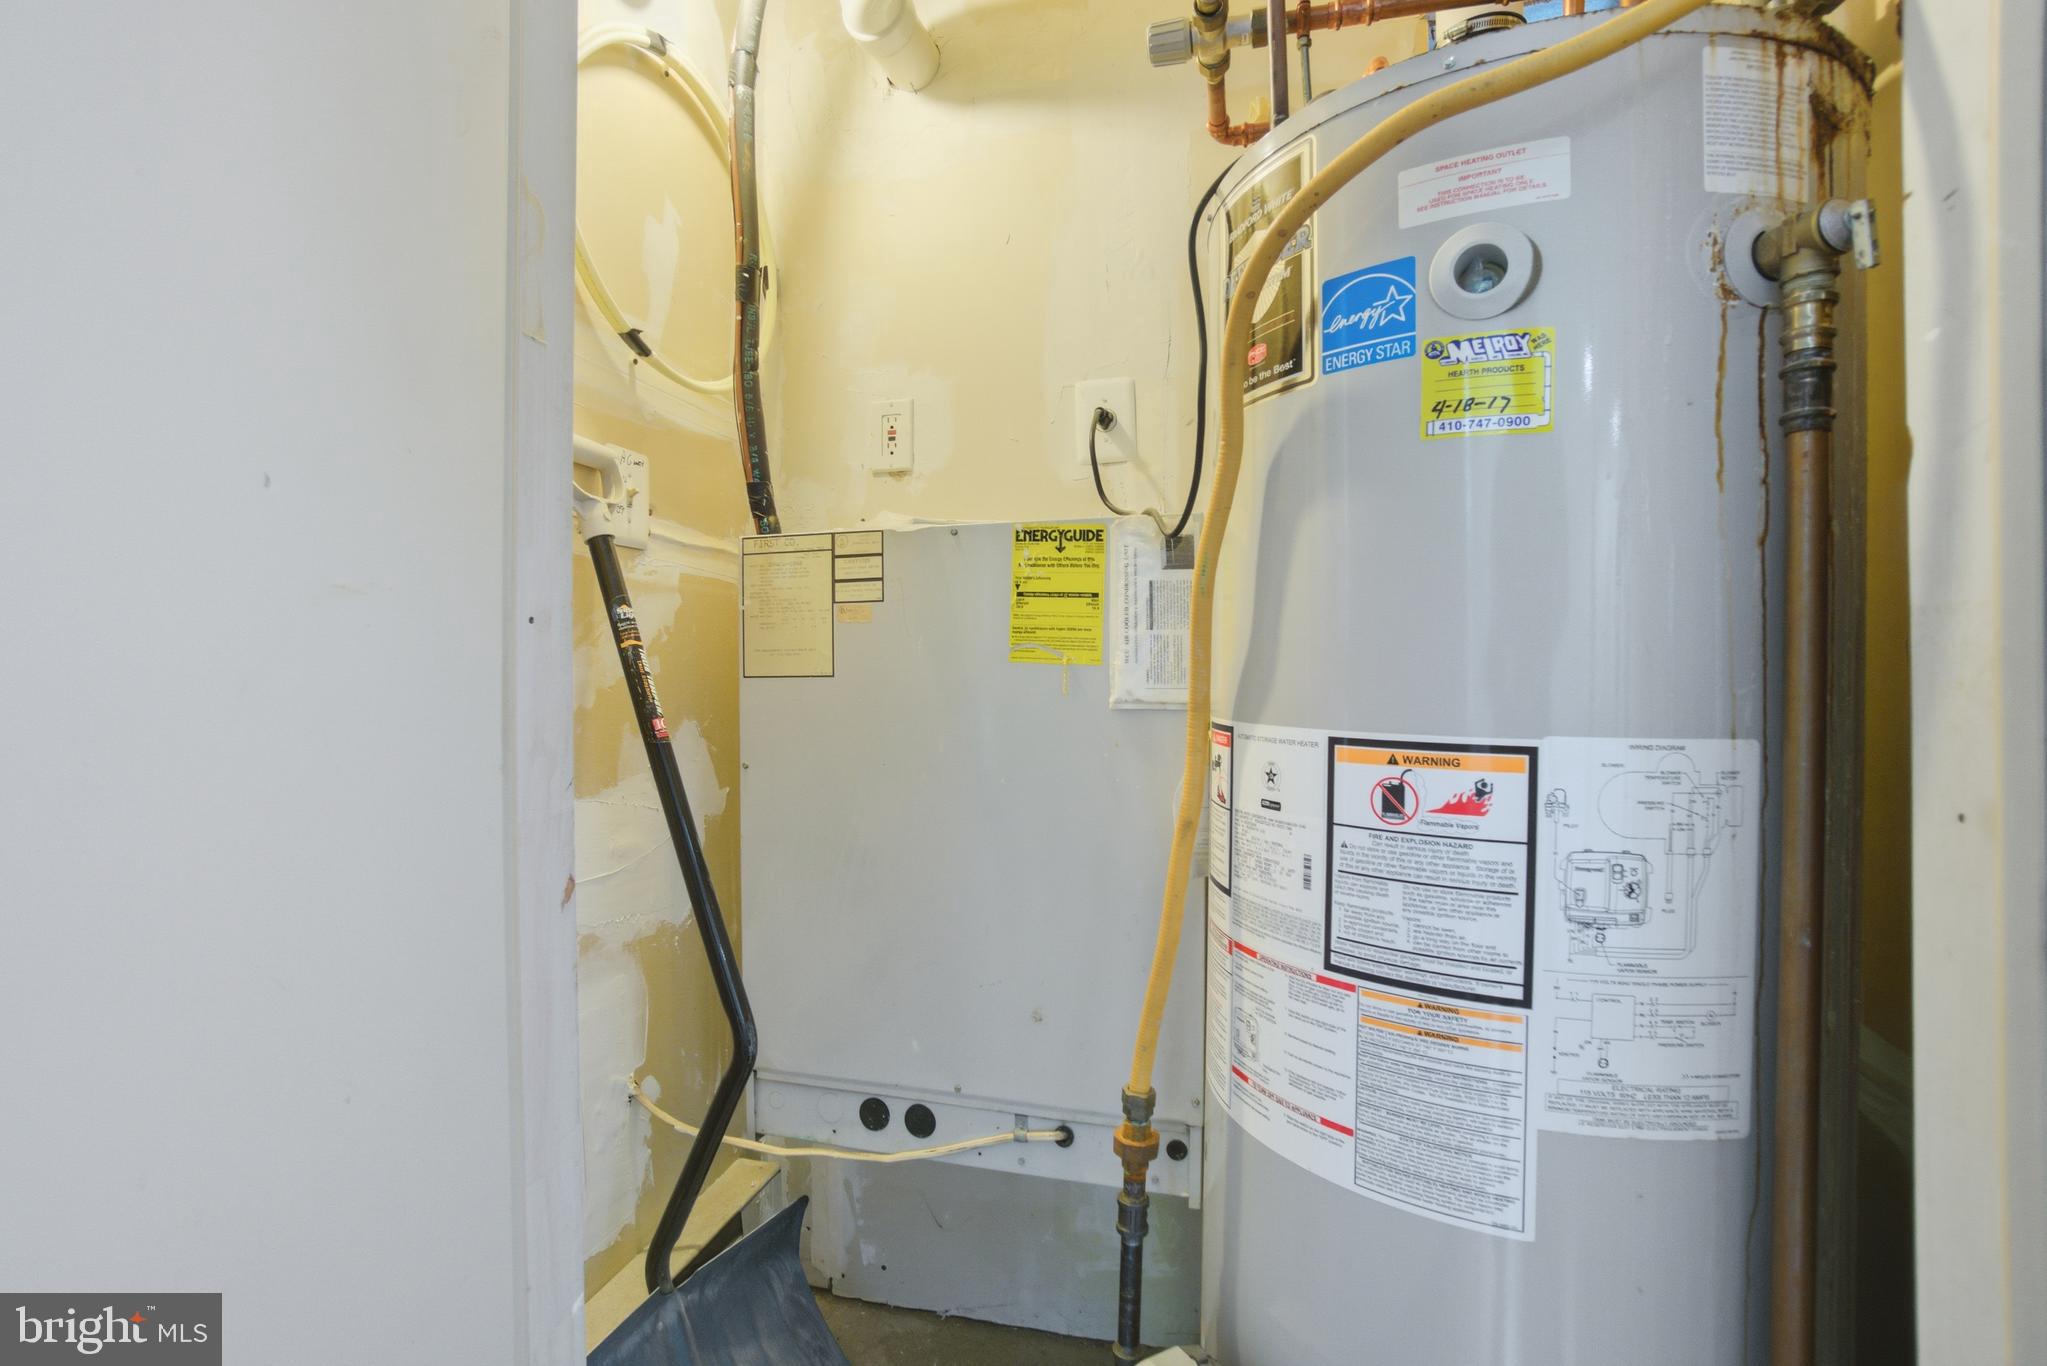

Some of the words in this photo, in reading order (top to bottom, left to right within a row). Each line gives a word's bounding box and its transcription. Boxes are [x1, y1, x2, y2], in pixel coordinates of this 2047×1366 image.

[1435, 161, 1458, 173] SPACE
[1461, 154, 1494, 167] HEATING
[1495, 147, 1527, 159] OUTLET
[1458, 168, 1502, 182] IMPORTANT
[1264, 188, 1298, 214] WHITE
[1325, 301, 1392, 334] energy
[1326, 349, 1373, 372] ENERGY
[1375, 340, 1411, 358] STAR
[1439, 332, 1532, 366] MELROY
[1249, 375, 1258, 386] be
[1259, 368, 1272, 382] the
[1447, 368, 1479, 378] HEARTH
[1481, 364, 1525, 375] PRODUCTS
[1431, 396, 1512, 420] 4-18-17
[1439, 415, 1531, 431] 410-747-0900
[1015, 529, 1104, 543] ENERGYGUIDE
[1402, 755, 1461, 768] WARNING
[1369, 832, 1383, 841] FIRE
[1400, 836, 1441, 847] EXPLOSION
[1442, 841, 1474, 850] HAZARD
[1424, 1003, 1460, 1015] WARNING
[1424, 1031, 1460, 1043] WARNING
